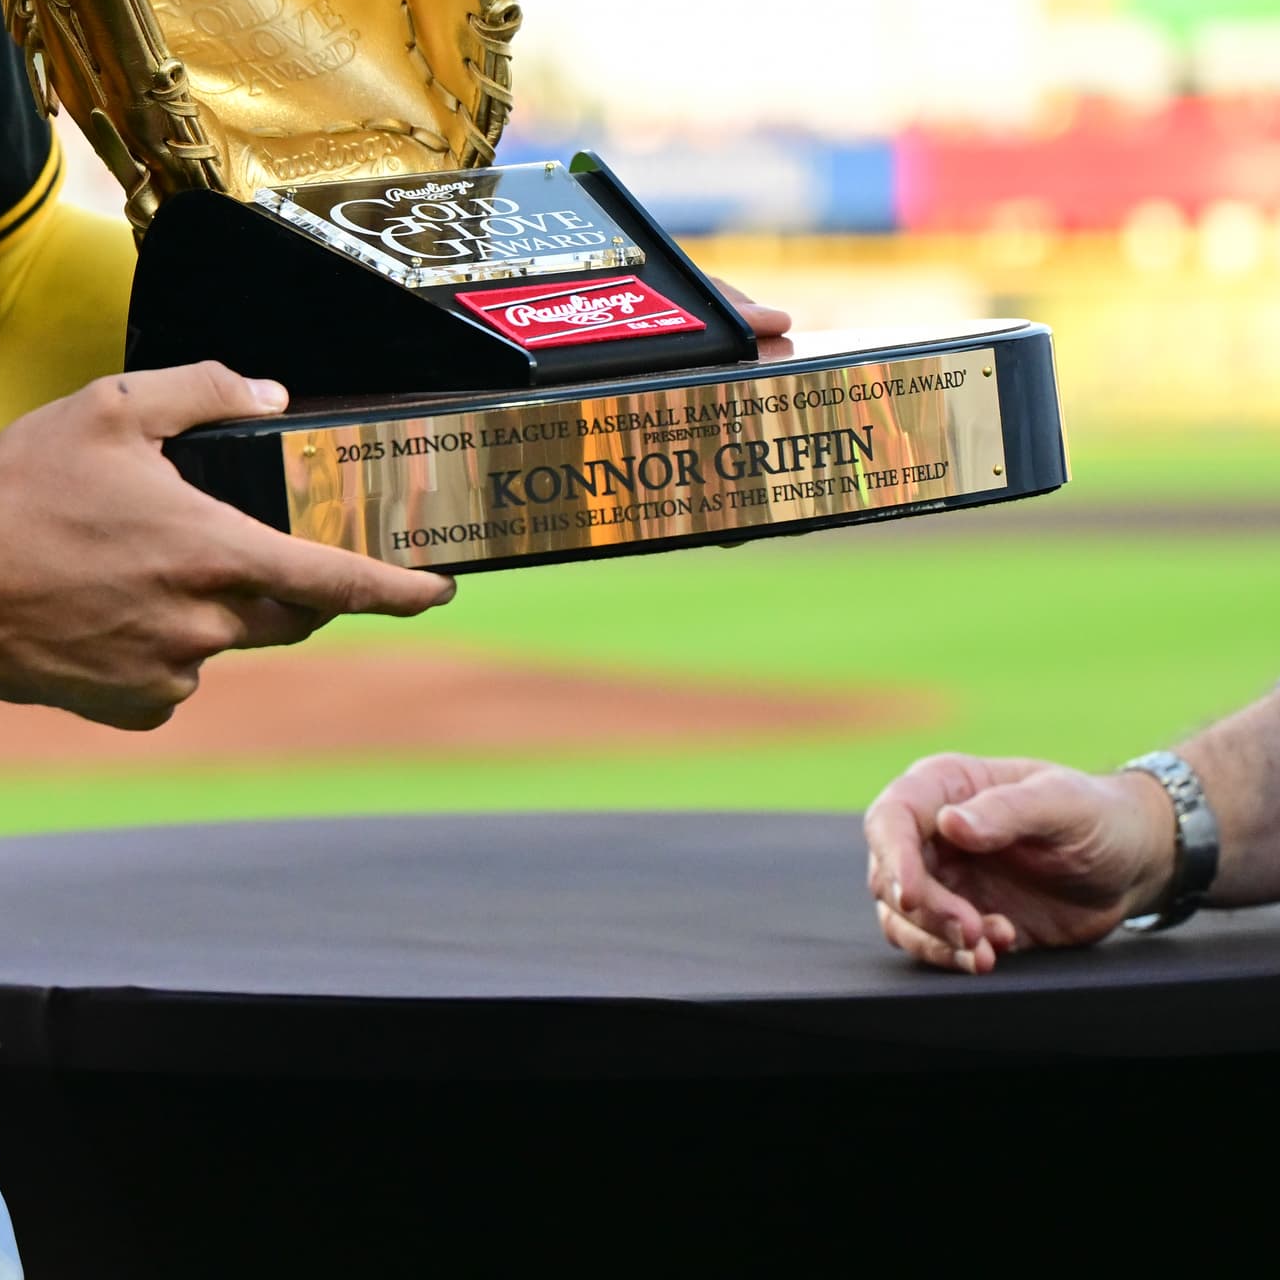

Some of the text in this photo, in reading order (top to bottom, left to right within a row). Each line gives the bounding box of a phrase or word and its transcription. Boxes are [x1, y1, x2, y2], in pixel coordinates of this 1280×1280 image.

[385, 179, 475, 203] Rawlings
[329, 196, 520, 237] GOLD
[380, 210, 594, 260] GLOVE
[504, 291, 645, 327] Rawlings
[337, 442, 385, 463] 2025
[392, 433, 476, 458] MINOR
[481, 420, 570, 448] LEAGUE
[576, 406, 681, 436] BASEBALL
[684, 394, 789, 423] RAWLINGS
[793, 388, 845, 410] GOLD
[849, 378, 906, 403] GLOVE
[643, 422, 743, 444] PRESENTED TO
[488, 425, 874, 510] KONNOR GRIFFIN
[392, 519, 527, 550] HONORING
[531, 512, 569, 534] HIS
[575, 497, 693, 528] SELECTION
[699, 494, 721, 513] AS
[726, 488, 769, 510] THE
[773, 478, 835, 503] FINEST
[841, 473, 861, 492] IN
[864, 469, 899, 490] THE
